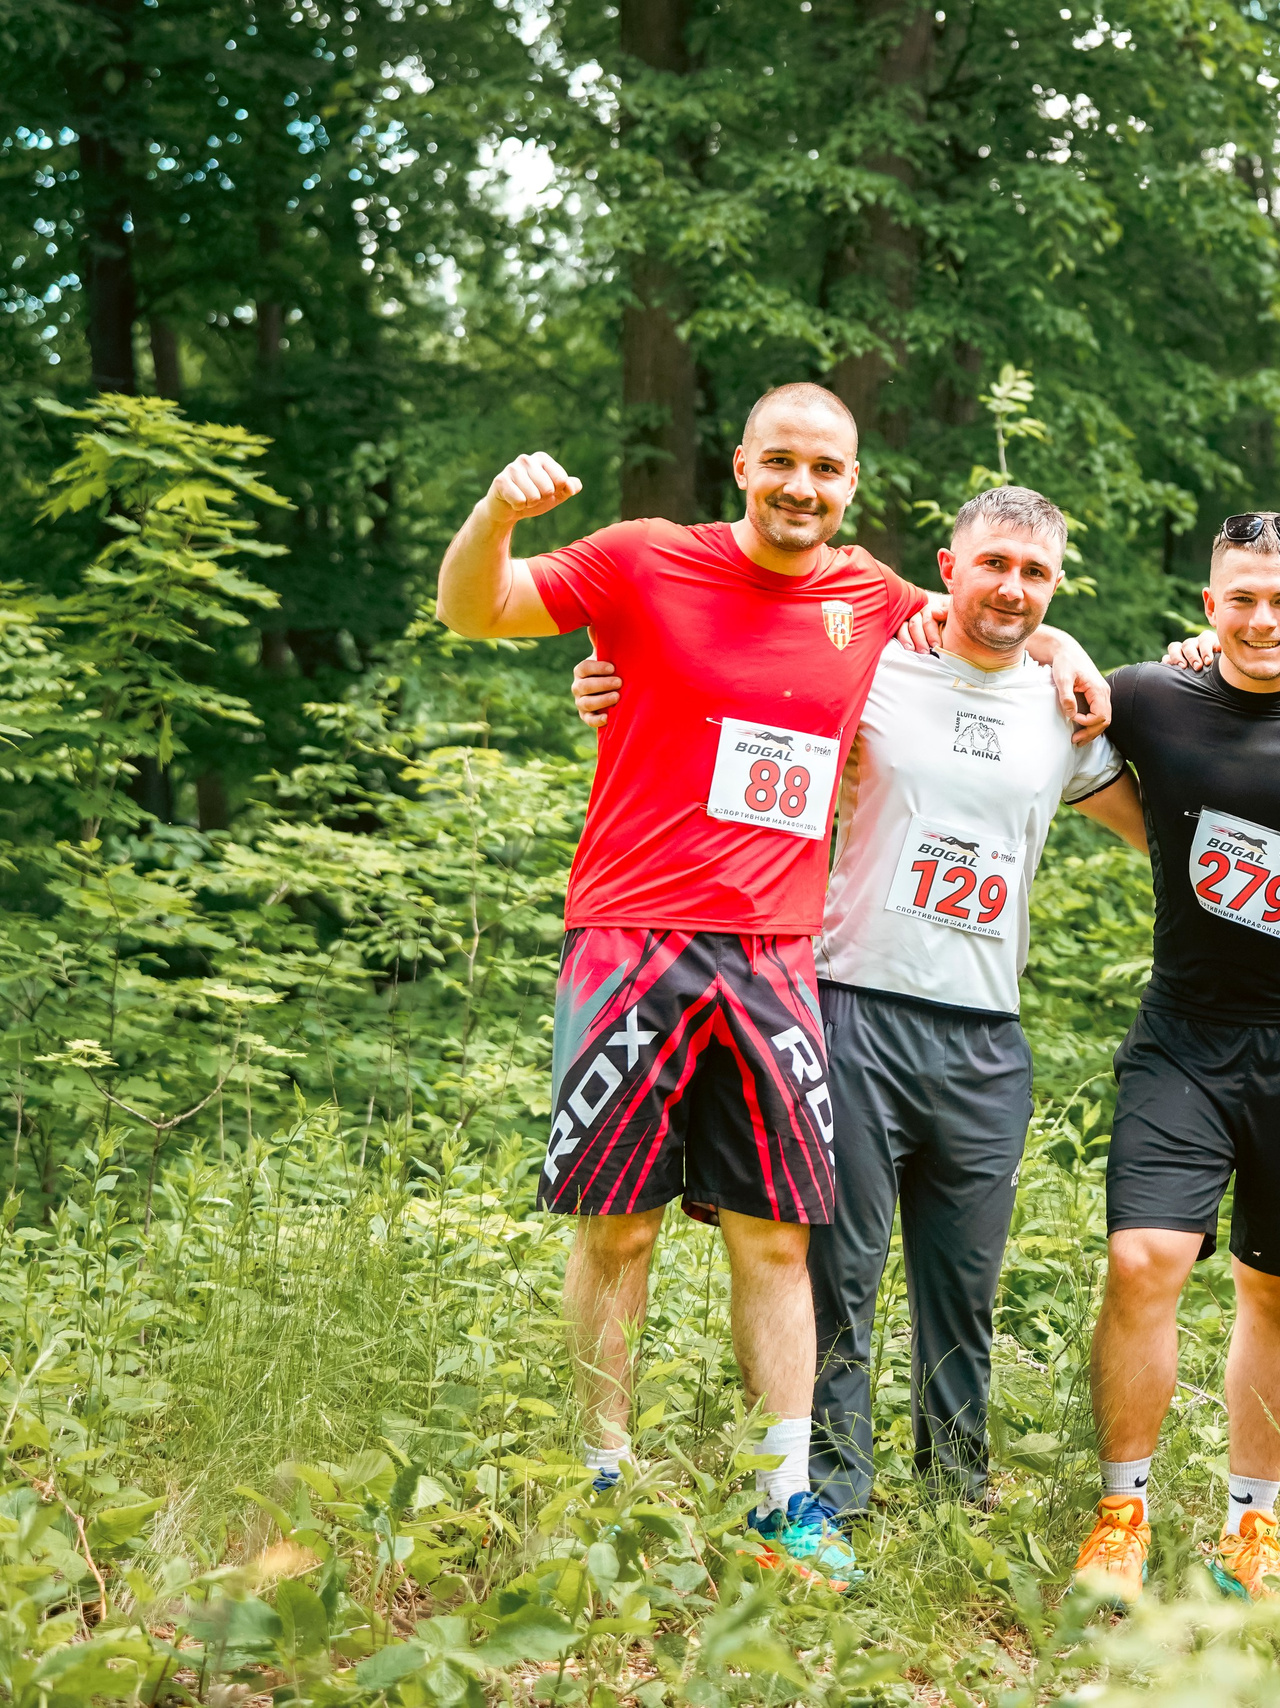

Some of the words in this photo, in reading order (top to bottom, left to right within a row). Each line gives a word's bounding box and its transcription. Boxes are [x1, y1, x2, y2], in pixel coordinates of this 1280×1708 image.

[956, 710, 977, 720] LLUITA
[734, 741, 794, 762] BOGAL
[953, 745, 968, 754] LA
[971, 749, 1001, 762] MINA
[744, 758, 811, 819] 88
[772, 817, 804, 829] МАРАФОН
[917, 843, 978, 868] BOGAL
[1206, 837, 1266, 865] BOGAL
[910, 859, 1008, 924] 129
[895, 905, 949, 925] СПОРТИВНЫЙ
[1235, 915, 1272, 933] МАРАФОН
[543, 1004, 660, 1186] RDX
[770, 1025, 836, 1190] RD
